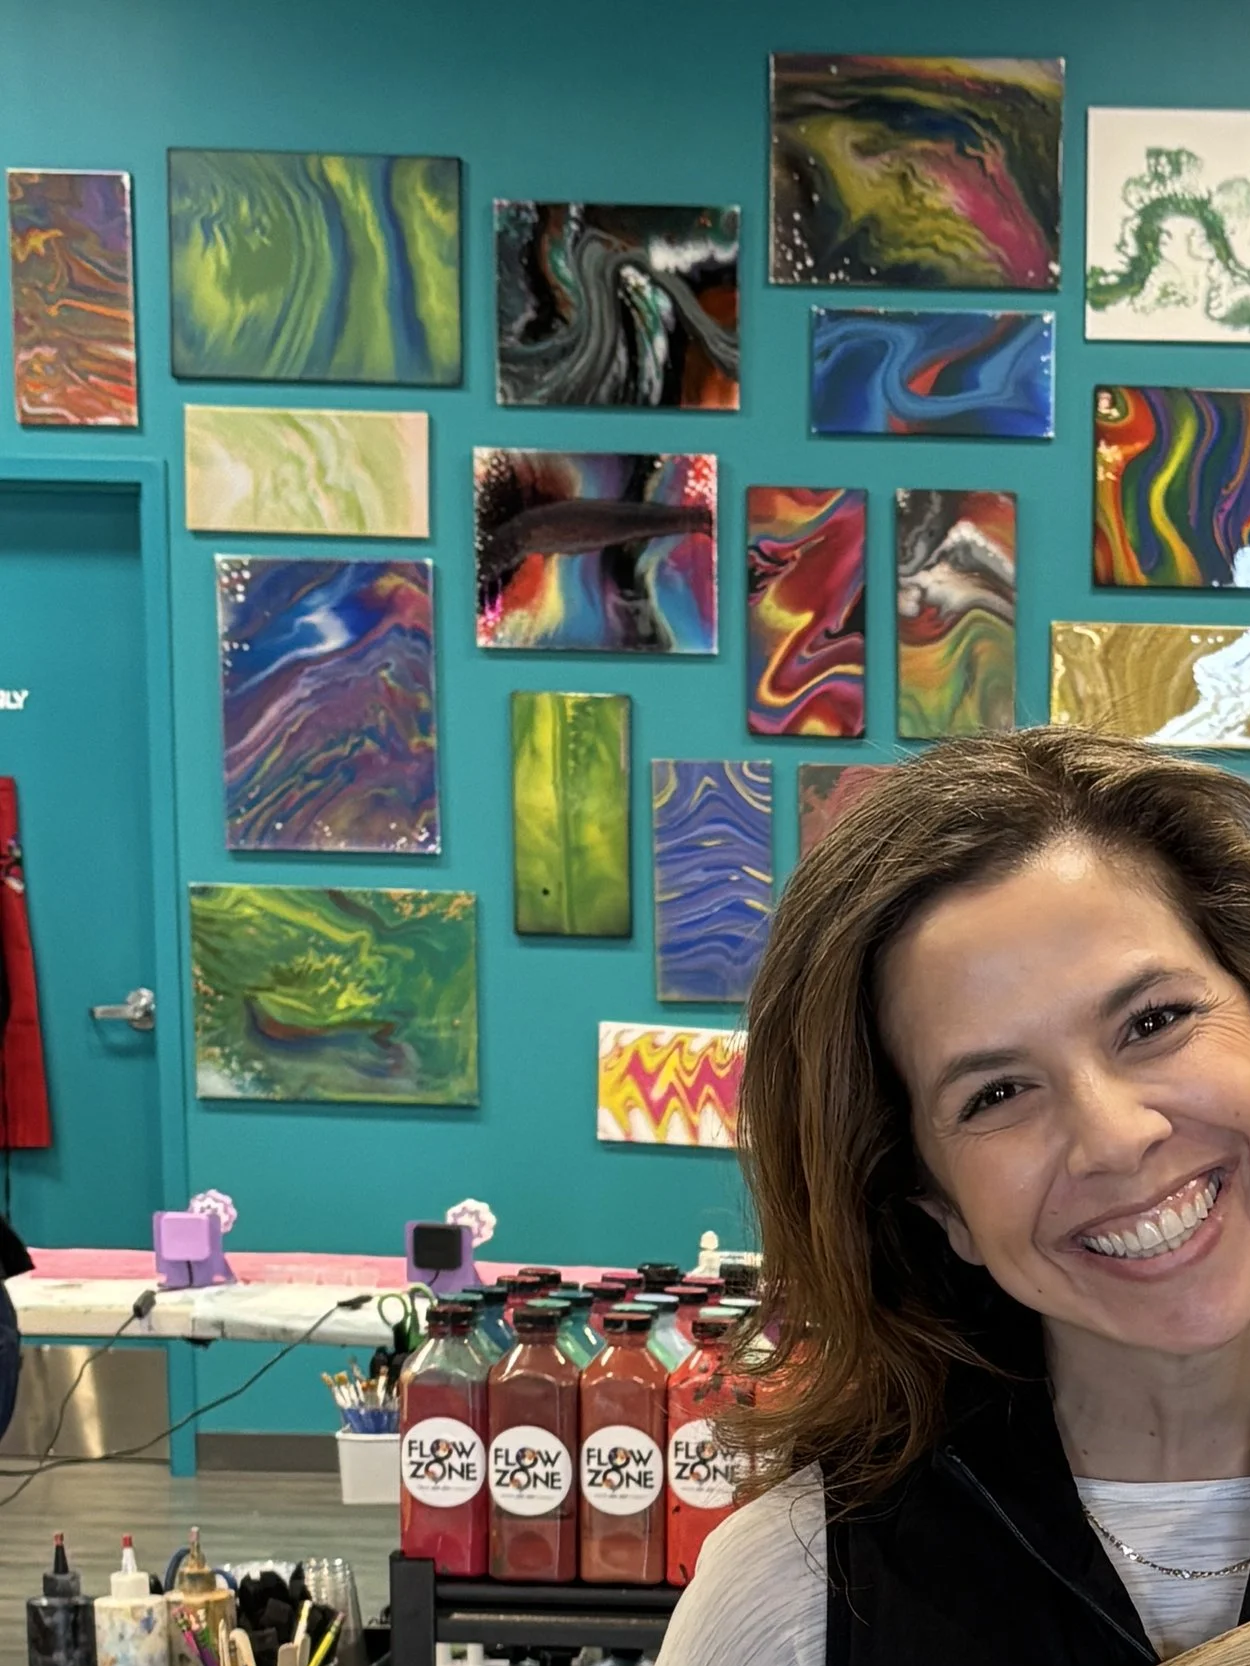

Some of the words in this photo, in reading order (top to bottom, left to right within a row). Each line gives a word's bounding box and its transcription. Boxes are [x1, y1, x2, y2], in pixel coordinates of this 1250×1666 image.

[408, 1438, 476, 1461] FLOW
[494, 1447, 562, 1469] FLOW
[586, 1447, 654, 1469] FLOW
[409, 1459, 477, 1484] ZONE
[495, 1467, 563, 1491] ZONE
[587, 1467, 655, 1491] ZONE
